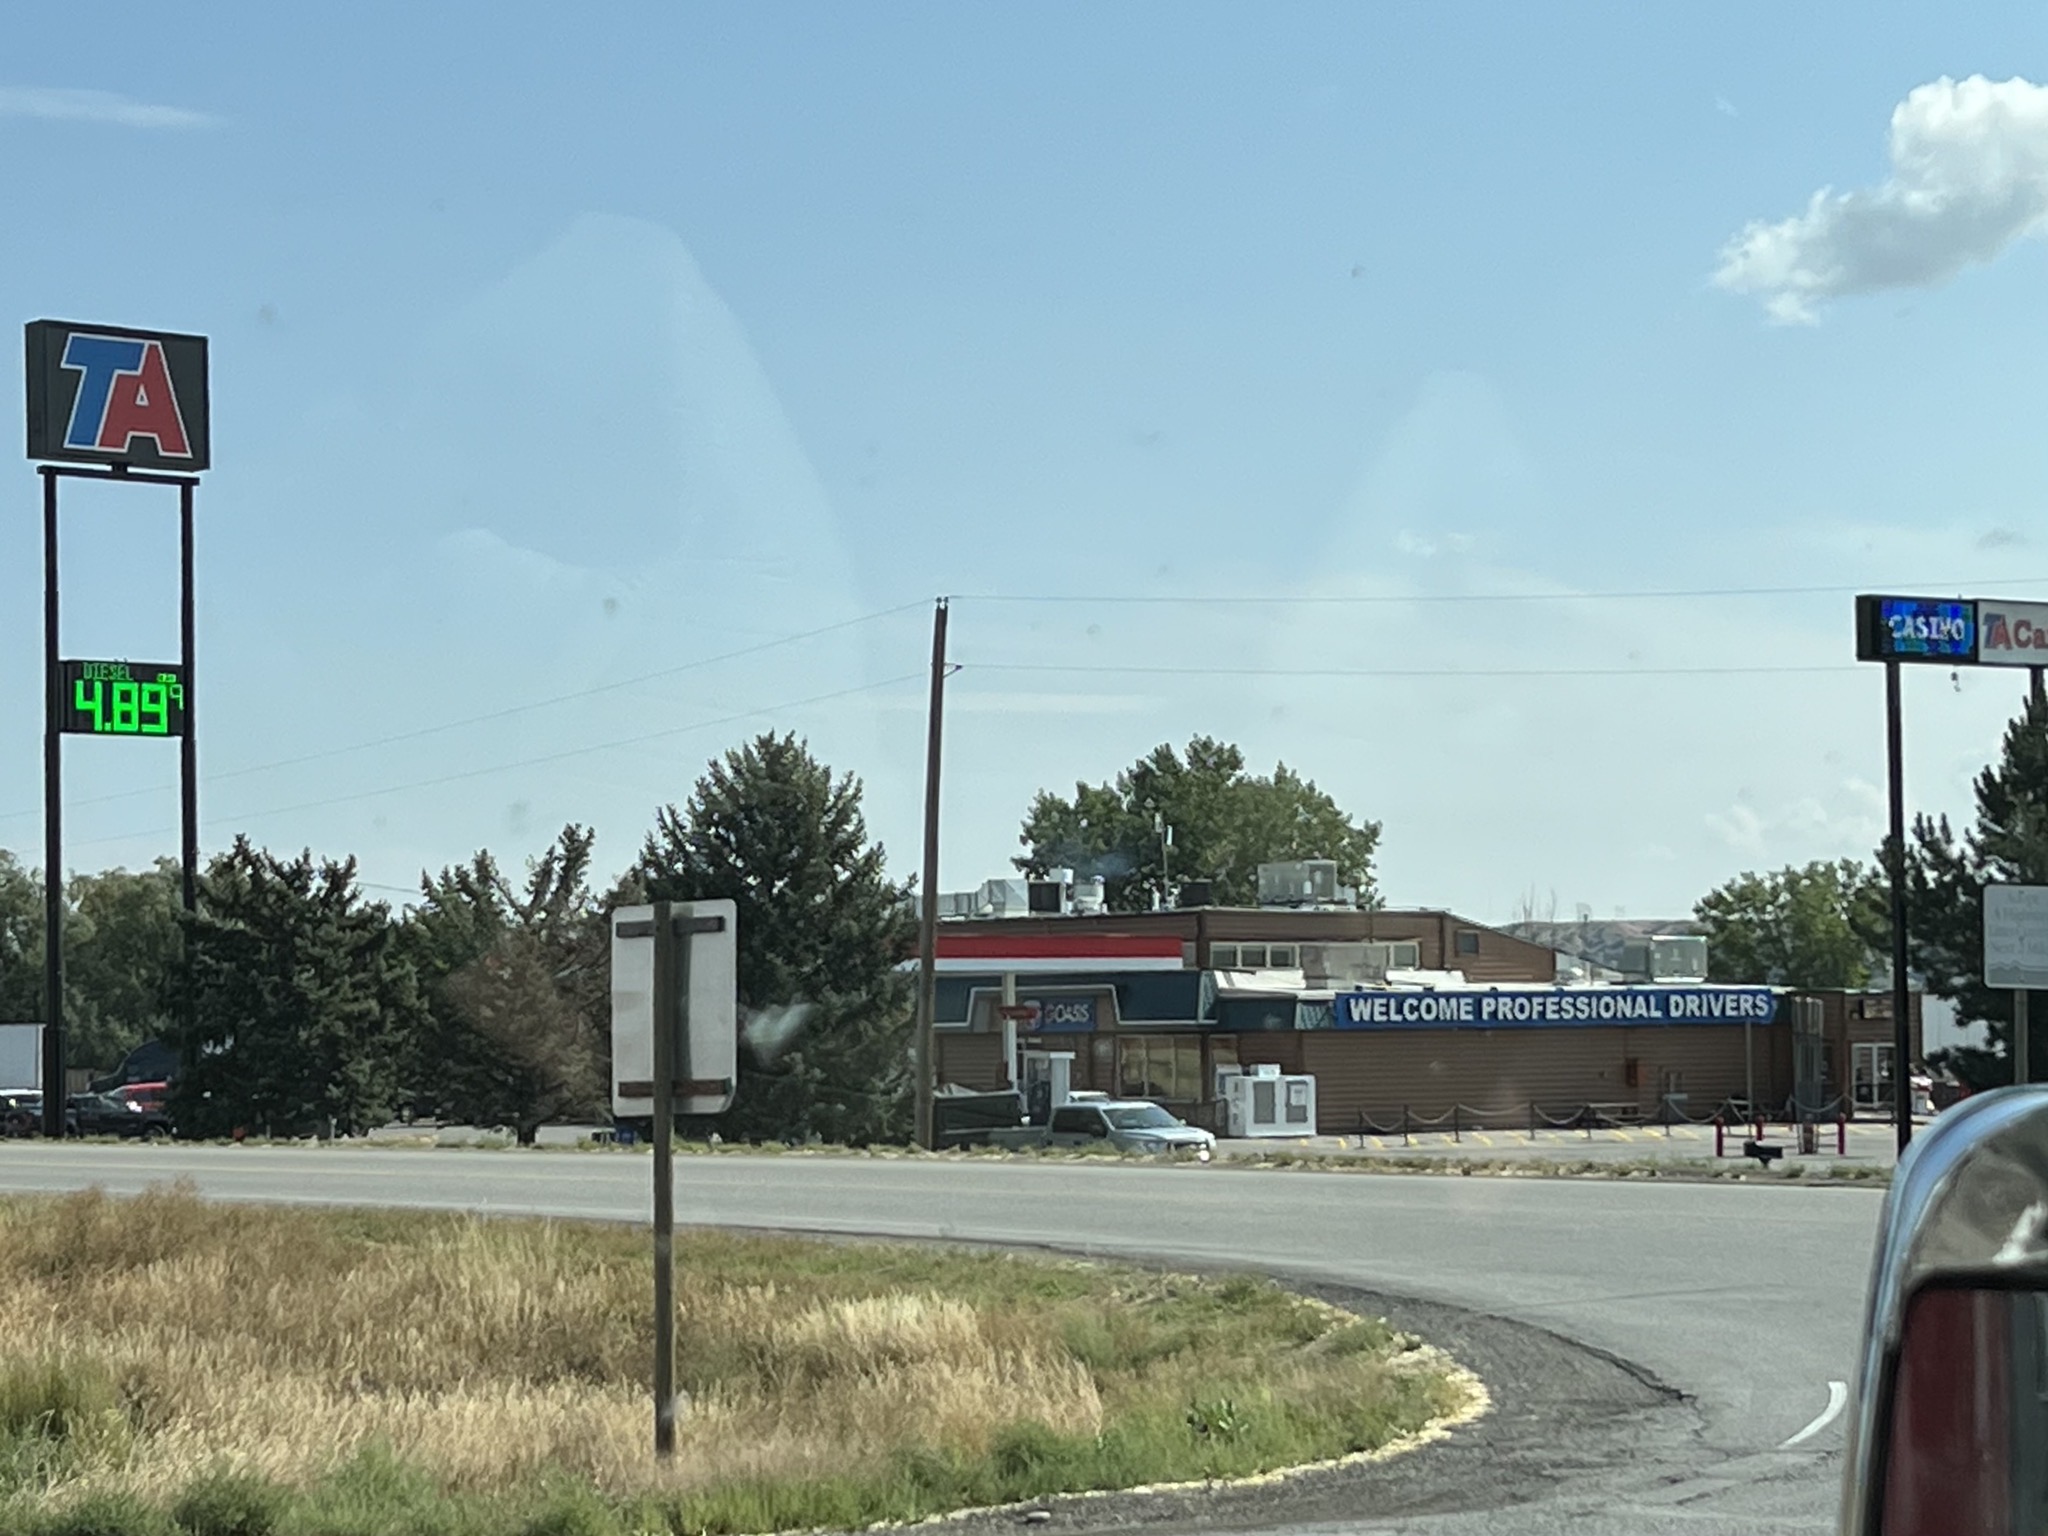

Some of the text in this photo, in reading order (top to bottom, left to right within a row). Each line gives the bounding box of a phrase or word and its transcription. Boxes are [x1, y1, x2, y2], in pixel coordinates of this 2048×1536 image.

[60, 333, 193, 458] TA
[1888, 614, 1966, 641] CASINO
[82, 662, 133, 680] DIESEL
[1350, 993, 1769, 1022] WELCOME PROFESSIONAL DRIVERS
